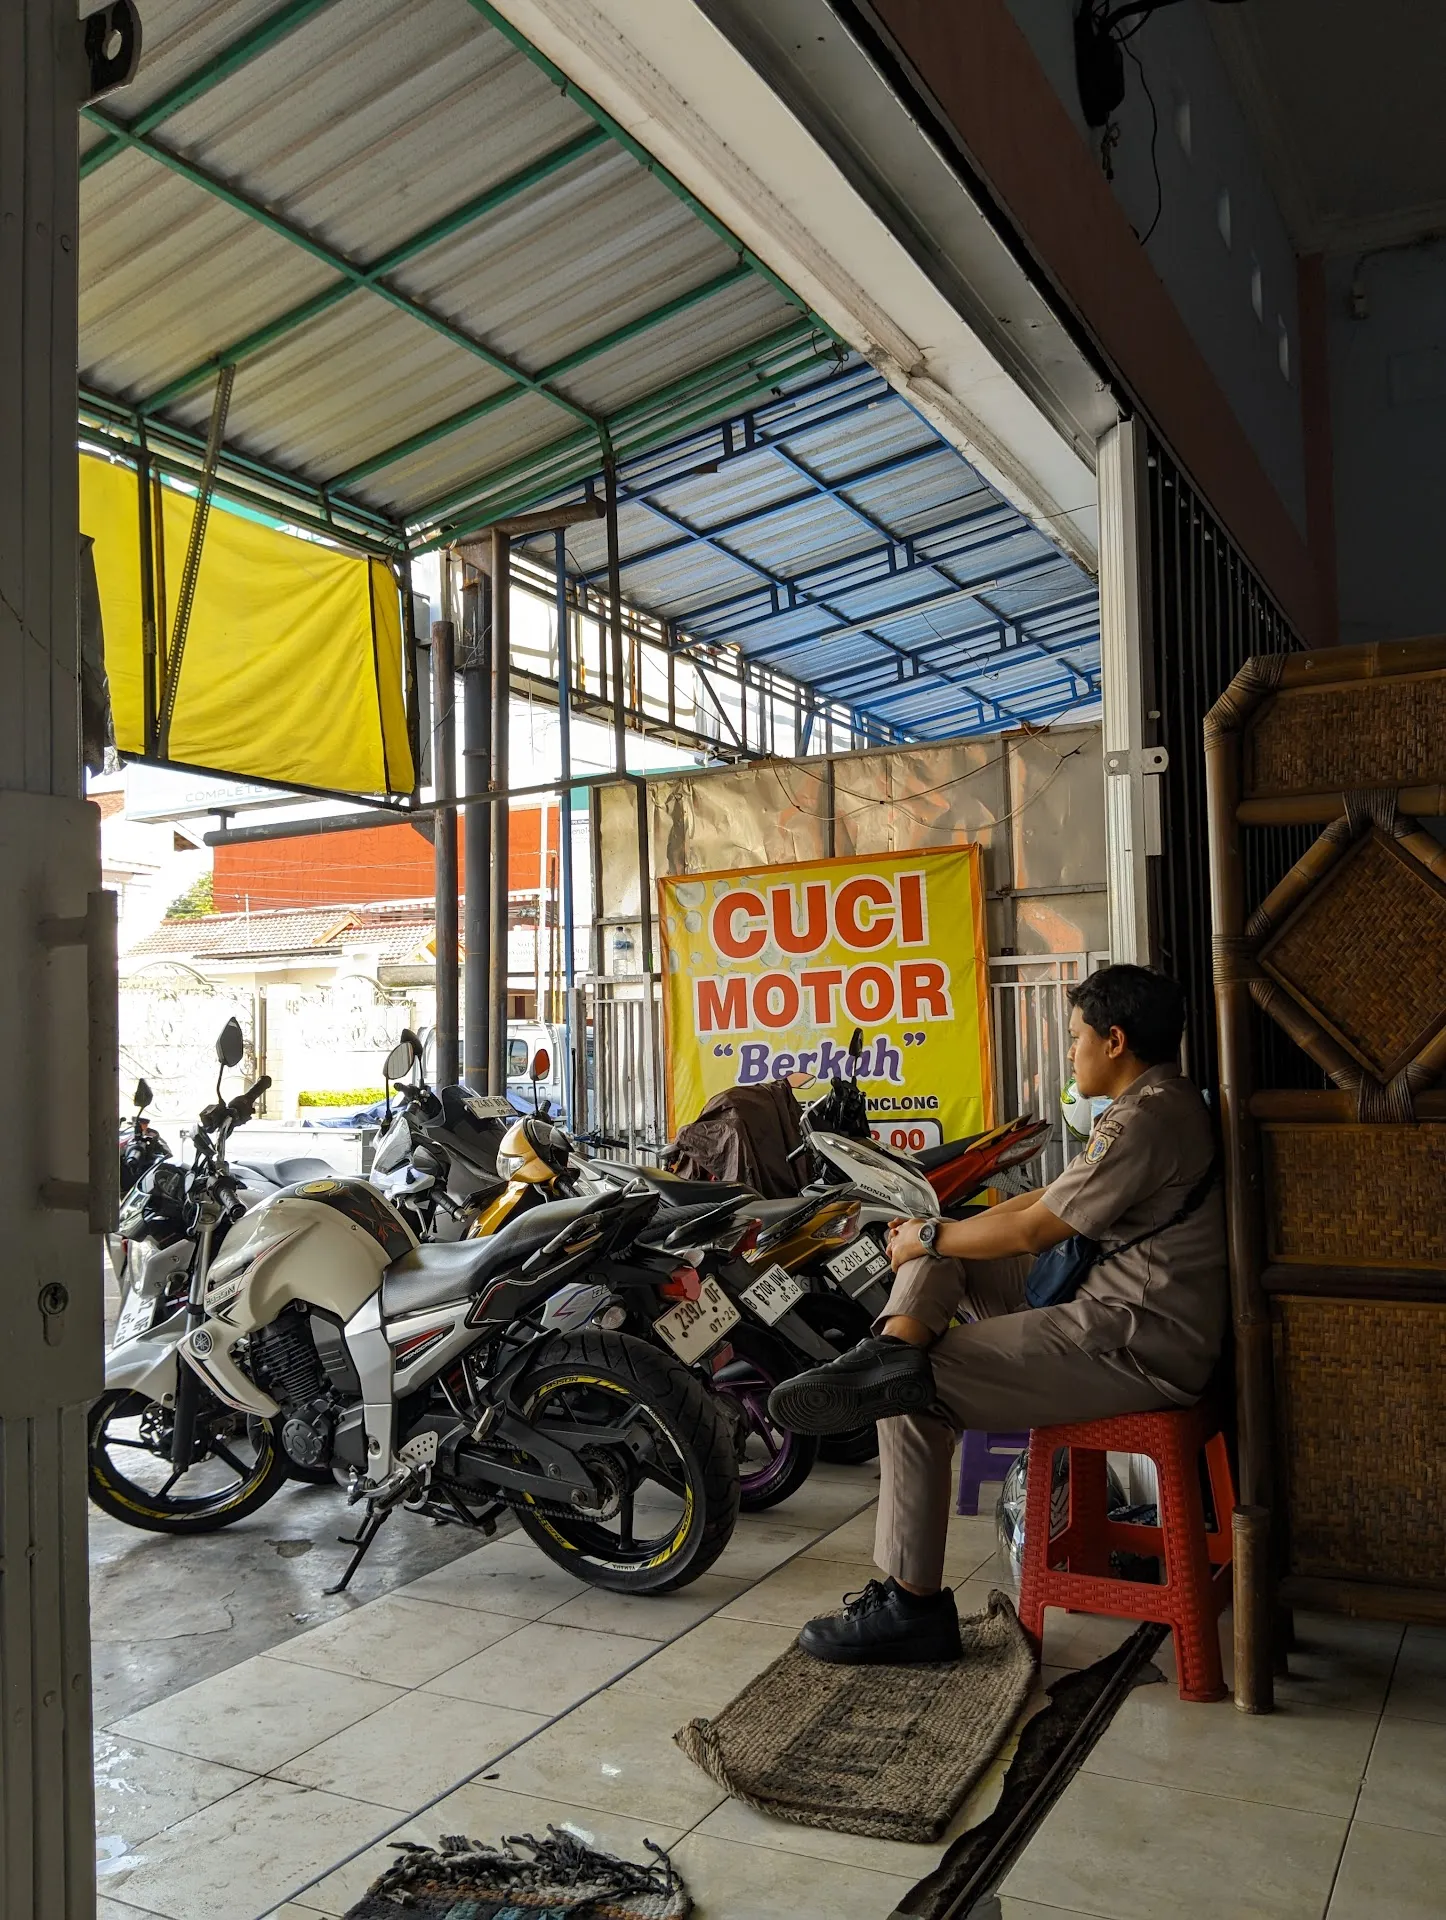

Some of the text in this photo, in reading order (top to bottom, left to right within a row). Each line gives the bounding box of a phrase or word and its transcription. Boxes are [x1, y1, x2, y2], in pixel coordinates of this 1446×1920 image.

[186, 784, 263, 802] COMPLETE
[711, 873, 925, 960] CUCI
[696, 961, 950, 1032] MOTOR
[866, 1095, 939, 1111] NCLONG
[860, 1183, 892, 1201] HONDA
[832, 1241, 875, 1279] R 2818 AF
[743, 1296, 758, 1310] B
[752, 1280, 776, 1302] 6708
[659, 1324, 676, 1342] R
[674, 1300, 707, 1331] 2392
